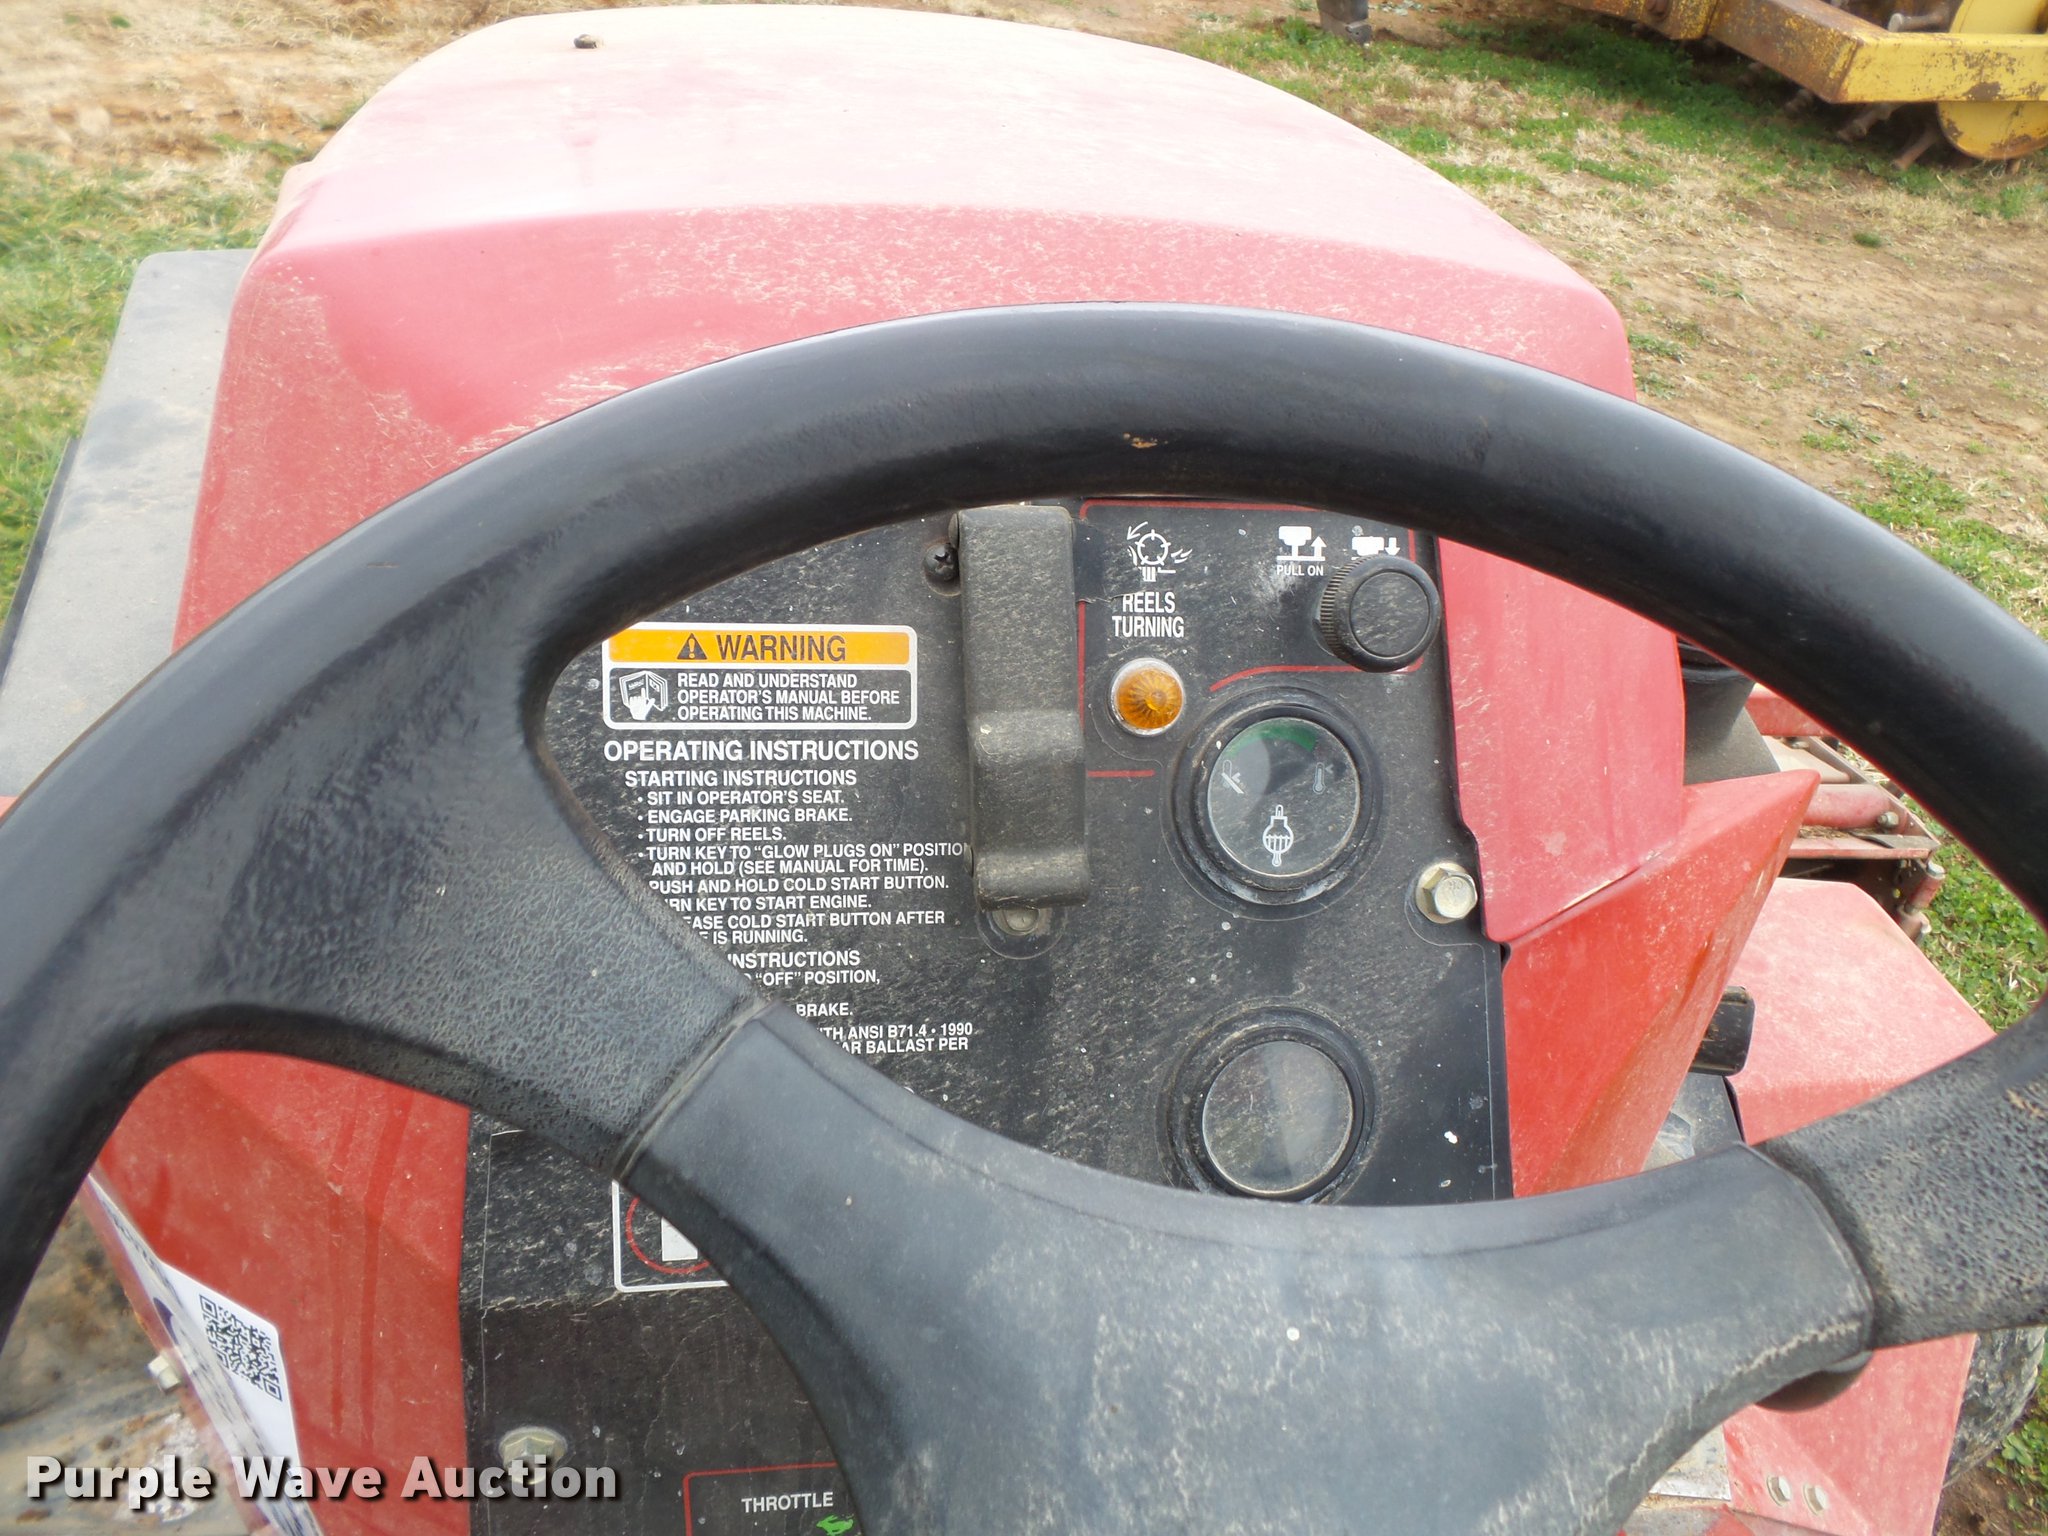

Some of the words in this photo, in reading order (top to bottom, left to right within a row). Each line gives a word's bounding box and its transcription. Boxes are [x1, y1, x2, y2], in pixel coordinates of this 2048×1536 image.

[1276, 565, 1305, 577] PULL
[1307, 565, 1324, 577] ON
[1122, 591, 1176, 614] REELS
[1112, 616, 1185, 638] TURNING
[716, 634, 846, 662] WARNING
[677, 672, 719, 688] READ
[723, 673, 755, 688] AND
[758, 673, 858, 688] UNDERSTAND
[677, 689, 772, 704] OPERATOR'S
[776, 690, 838, 705] MANUAL
[841, 690, 900, 705] BEFORE
[677, 706, 762, 721] OPERATING
[765, 706, 799, 721] THIS
[802, 706, 872, 721] MACHINE.
[603, 740, 743, 762] OPERATING
[750, 740, 919, 761] INSTRUCTIONS
[625, 770, 718, 788] STARTING
[723, 769, 857, 787] INSTRUCTIONS
[647, 791, 673, 805] SIT
[677, 791, 693, 805] IN
[697, 790, 798, 805] OPERATOR'S
[802, 789, 845, 804] SEAT.
[648, 809, 716, 824] ENGAGE
[720, 808, 790, 823] PARKING
[794, 807, 853, 822] BRAKE.
[646, 828, 691, 842] TURN
[695, 827, 726, 841] OFF
[730, 826, 787, 841] REELS.
[646, 846, 691, 861] TURN
[695, 845, 727, 860] KEY
[728, 845, 751, 860] TO
[813, 843, 866, 858] PLUGS
[903, 842, 967, 857] POSITIO
[652, 862, 687, 876] AND
[690, 861, 735, 876] HOLD
[739, 860, 775, 877] (SEE
[779, 859, 845, 874] MANUAL
[849, 858, 881, 873] FOR
[883, 857, 929, 874] TIME).
[649, 880, 693, 894] PUSH
[697, 879, 731, 893] AND
[735, 878, 779, 893] HOLD
[783, 877, 827, 892] COLD
[830, 876, 880, 891] START
[884, 875, 949, 890] BUTTON.
[665, 898, 692, 912] RN
[696, 898, 728, 911] KEY
[729, 897, 752, 911] TO
[755, 896, 806, 910] START
[810, 894, 872, 909] ENGINE.
[727, 914, 772, 929] COLD
[776, 913, 826, 928] START
[829, 912, 892, 927] BUTTON
[895, 911, 945, 926] AFTER
[713, 930, 728, 945] IS
[732, 929, 808, 944] RUNNING.
[804, 969, 880, 985] POSITION,
[796, 1002, 853, 1017] BRAKE.
[848, 1025, 883, 1040] ANSI
[887, 1024, 927, 1038] B71.4
[940, 1022, 973, 1036] 1990
[866, 1038, 934, 1054] BALLAST
[938, 1037, 969, 1051] PER
[741, 1491, 834, 1513] THROTTLE
